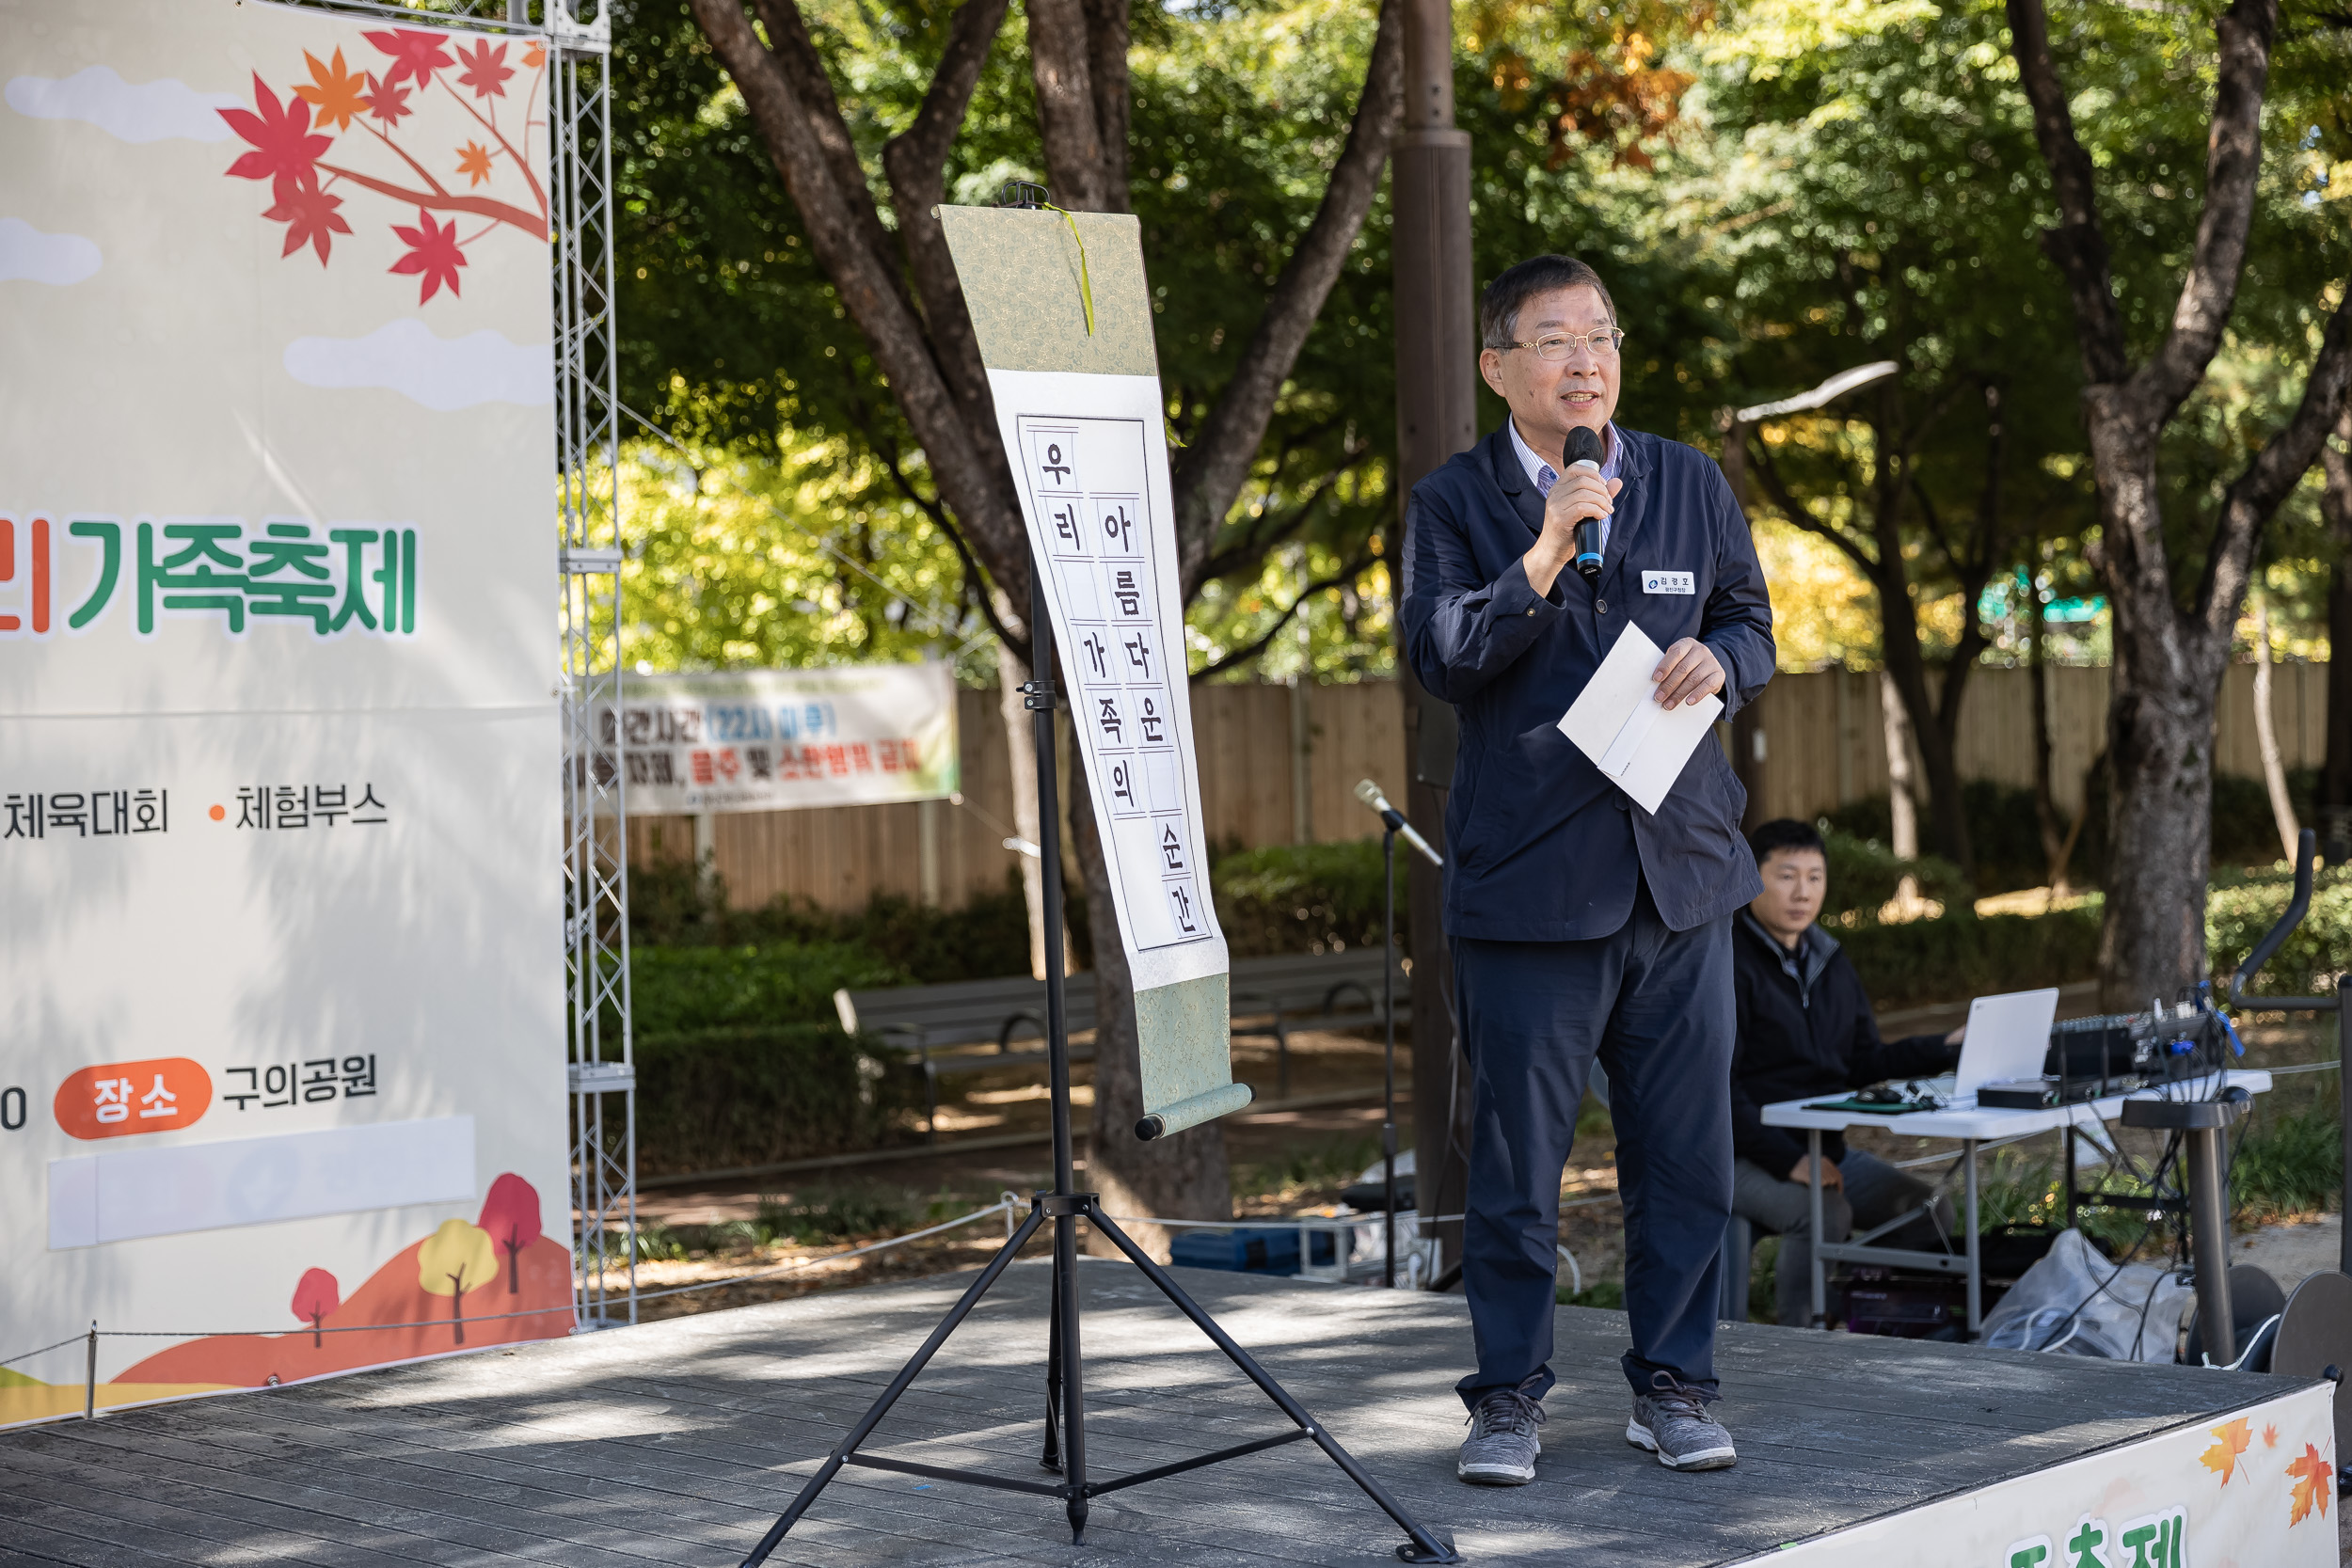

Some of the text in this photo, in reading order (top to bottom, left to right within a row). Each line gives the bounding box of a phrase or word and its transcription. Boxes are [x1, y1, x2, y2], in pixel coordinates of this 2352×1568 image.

[1042, 443, 1135, 808] 우리 가족의
[1104, 505, 1197, 933] 아름다운 순간
[3, 783, 389, 840] 체육대회 체험부스
[223, 1053, 378, 1112] 구의공원
